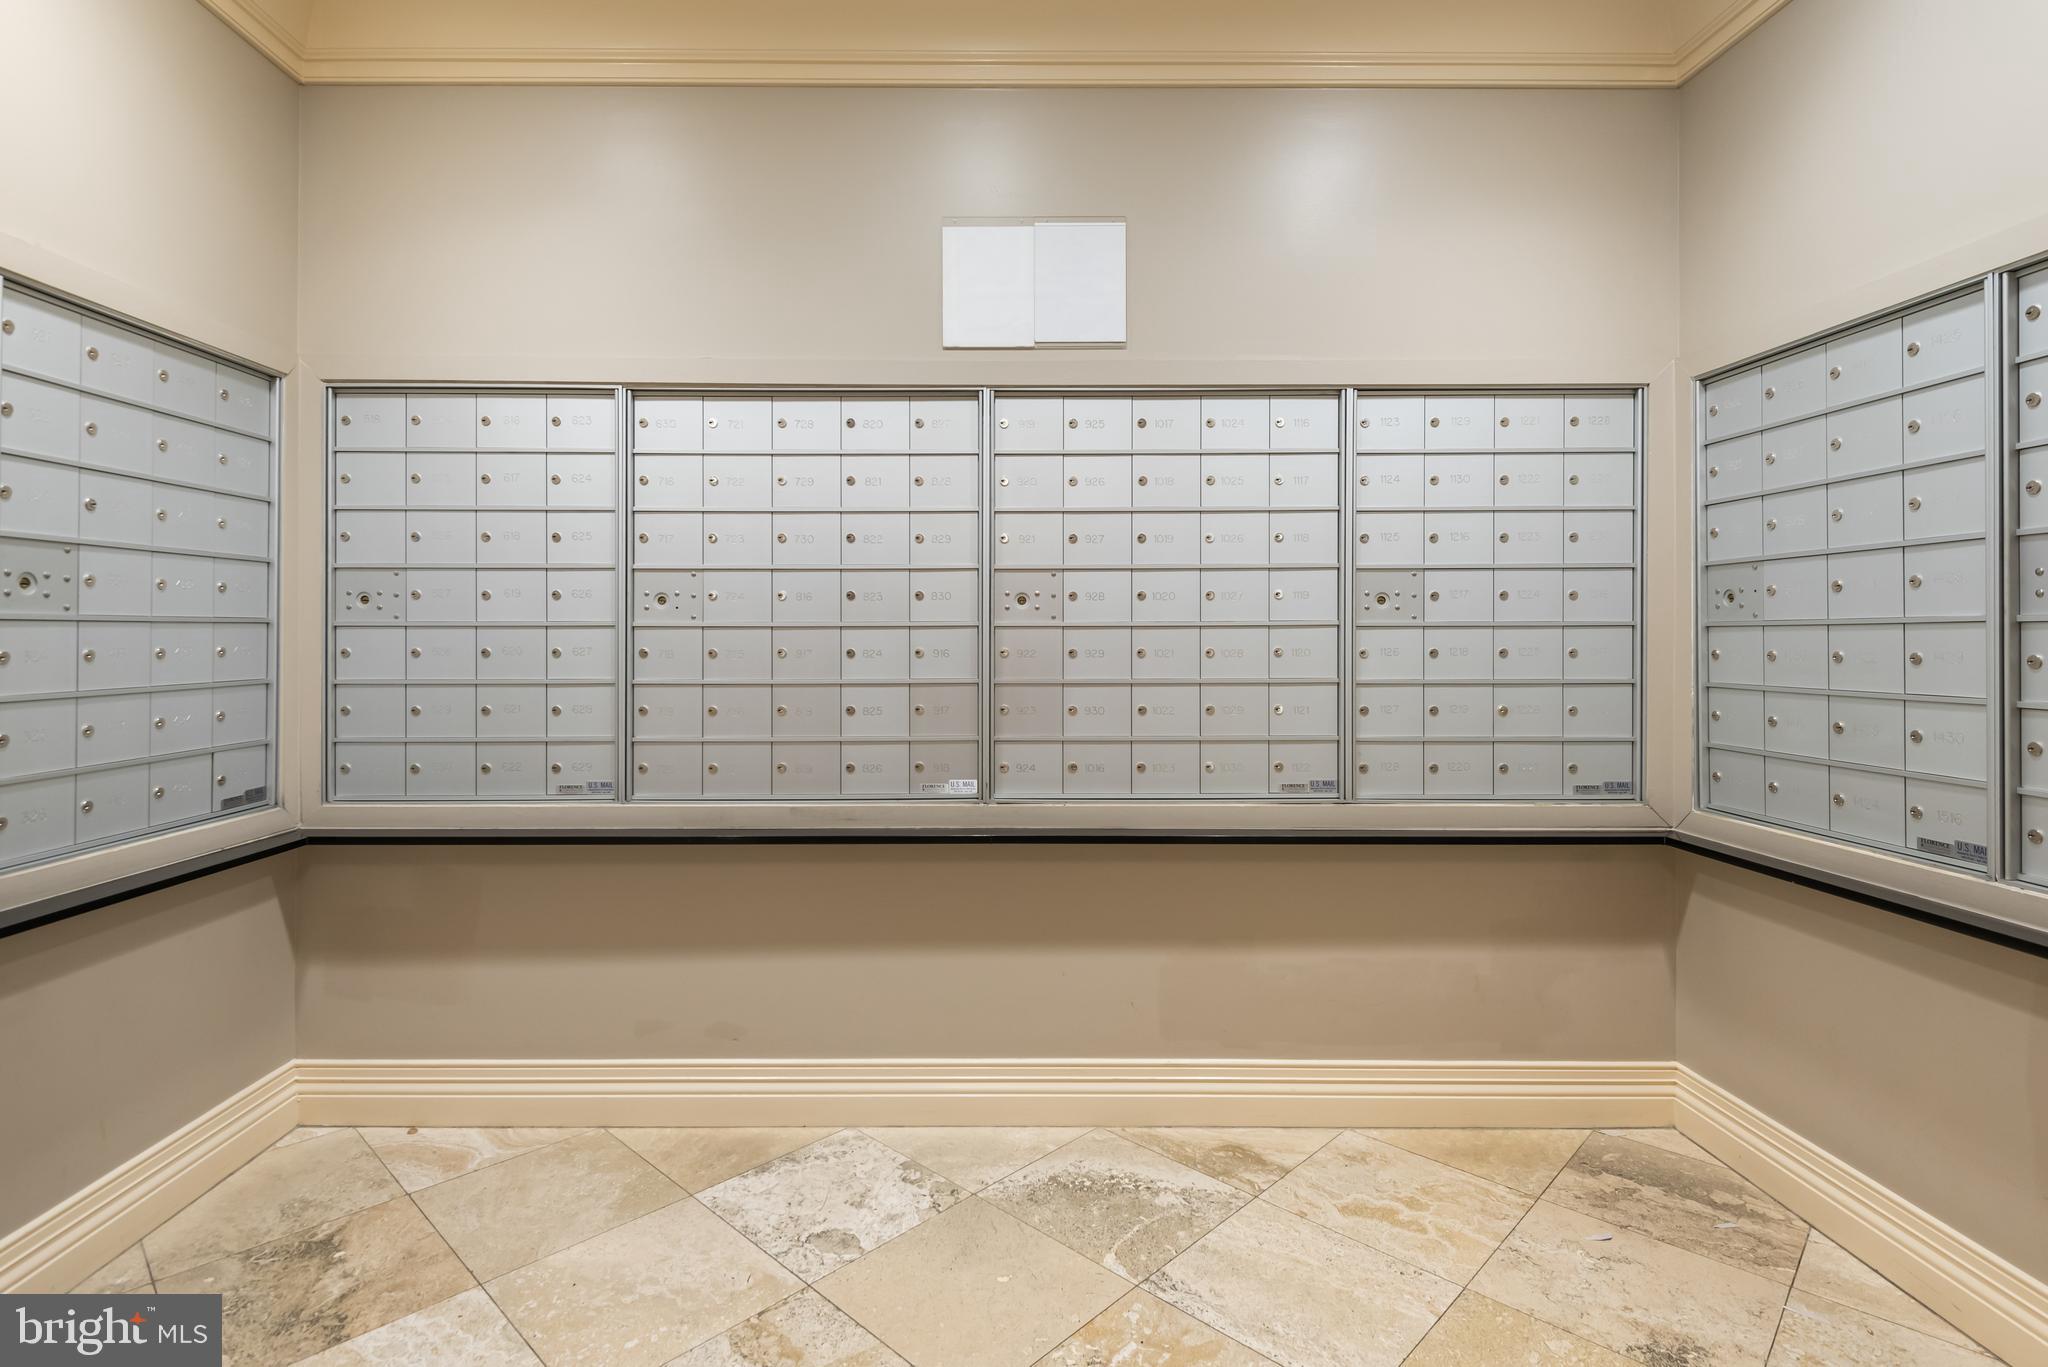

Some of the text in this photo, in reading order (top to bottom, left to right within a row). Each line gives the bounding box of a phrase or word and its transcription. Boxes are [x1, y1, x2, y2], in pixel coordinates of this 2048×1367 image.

[572, 415, 592, 426] 623
[728, 419, 744, 429] 721
[795, 419, 814, 429] 728
[862, 419, 884, 429] 820
[1084, 419, 1105, 429] 925
[1154, 418, 1174, 429] 1017
[1221, 418, 1244, 428] 1024
[1294, 418, 1310, 428] 1116
[1380, 417, 1400, 427] 1123
[1451, 416, 1471, 426] 1129
[571, 473, 592, 483] 624
[795, 477, 814, 487] 729
[864, 477, 882, 487] 821
[1084, 477, 1105, 487] 926
[1154, 476, 1175, 486] 1018
[1220, 476, 1244, 486] 1025
[1294, 475, 1309, 485] 1117
[1380, 474, 1400, 484] 1124
[1450, 474, 1471, 484] 1130
[571, 531, 592, 541] 625
[794, 534, 815, 544] 730
[863, 534, 883, 544] 822
[1084, 534, 1104, 544] 927
[1154, 534, 1174, 544] 1019
[1220, 533, 1244, 544] 1026
[1294, 533, 1310, 543] 1118
[571, 589, 592, 599] 626
[795, 591, 813, 602] 816
[931, 591, 952, 601] 830
[1085, 591, 1105, 601] 928
[1152, 591, 1176, 601] 1020
[1293, 590, 1310, 600] 1119
[572, 646, 592, 657] 627
[862, 649, 882, 659] 824
[932, 648, 950, 658] 916
[1016, 648, 1037, 659] 922
[1084, 648, 1105, 659] 929
[1291, 647, 1311, 658] 1120
[862, 706, 883, 716] 825
[1084, 706, 1105, 716] 930
[1152, 705, 1175, 716] 1022
[1293, 705, 1310, 715] 1121
[1380, 704, 1399, 714] 1127
[862, 763, 883, 774] 826
[1016, 763, 1036, 773] 924
[1974, 845, 1987, 856] MAI
